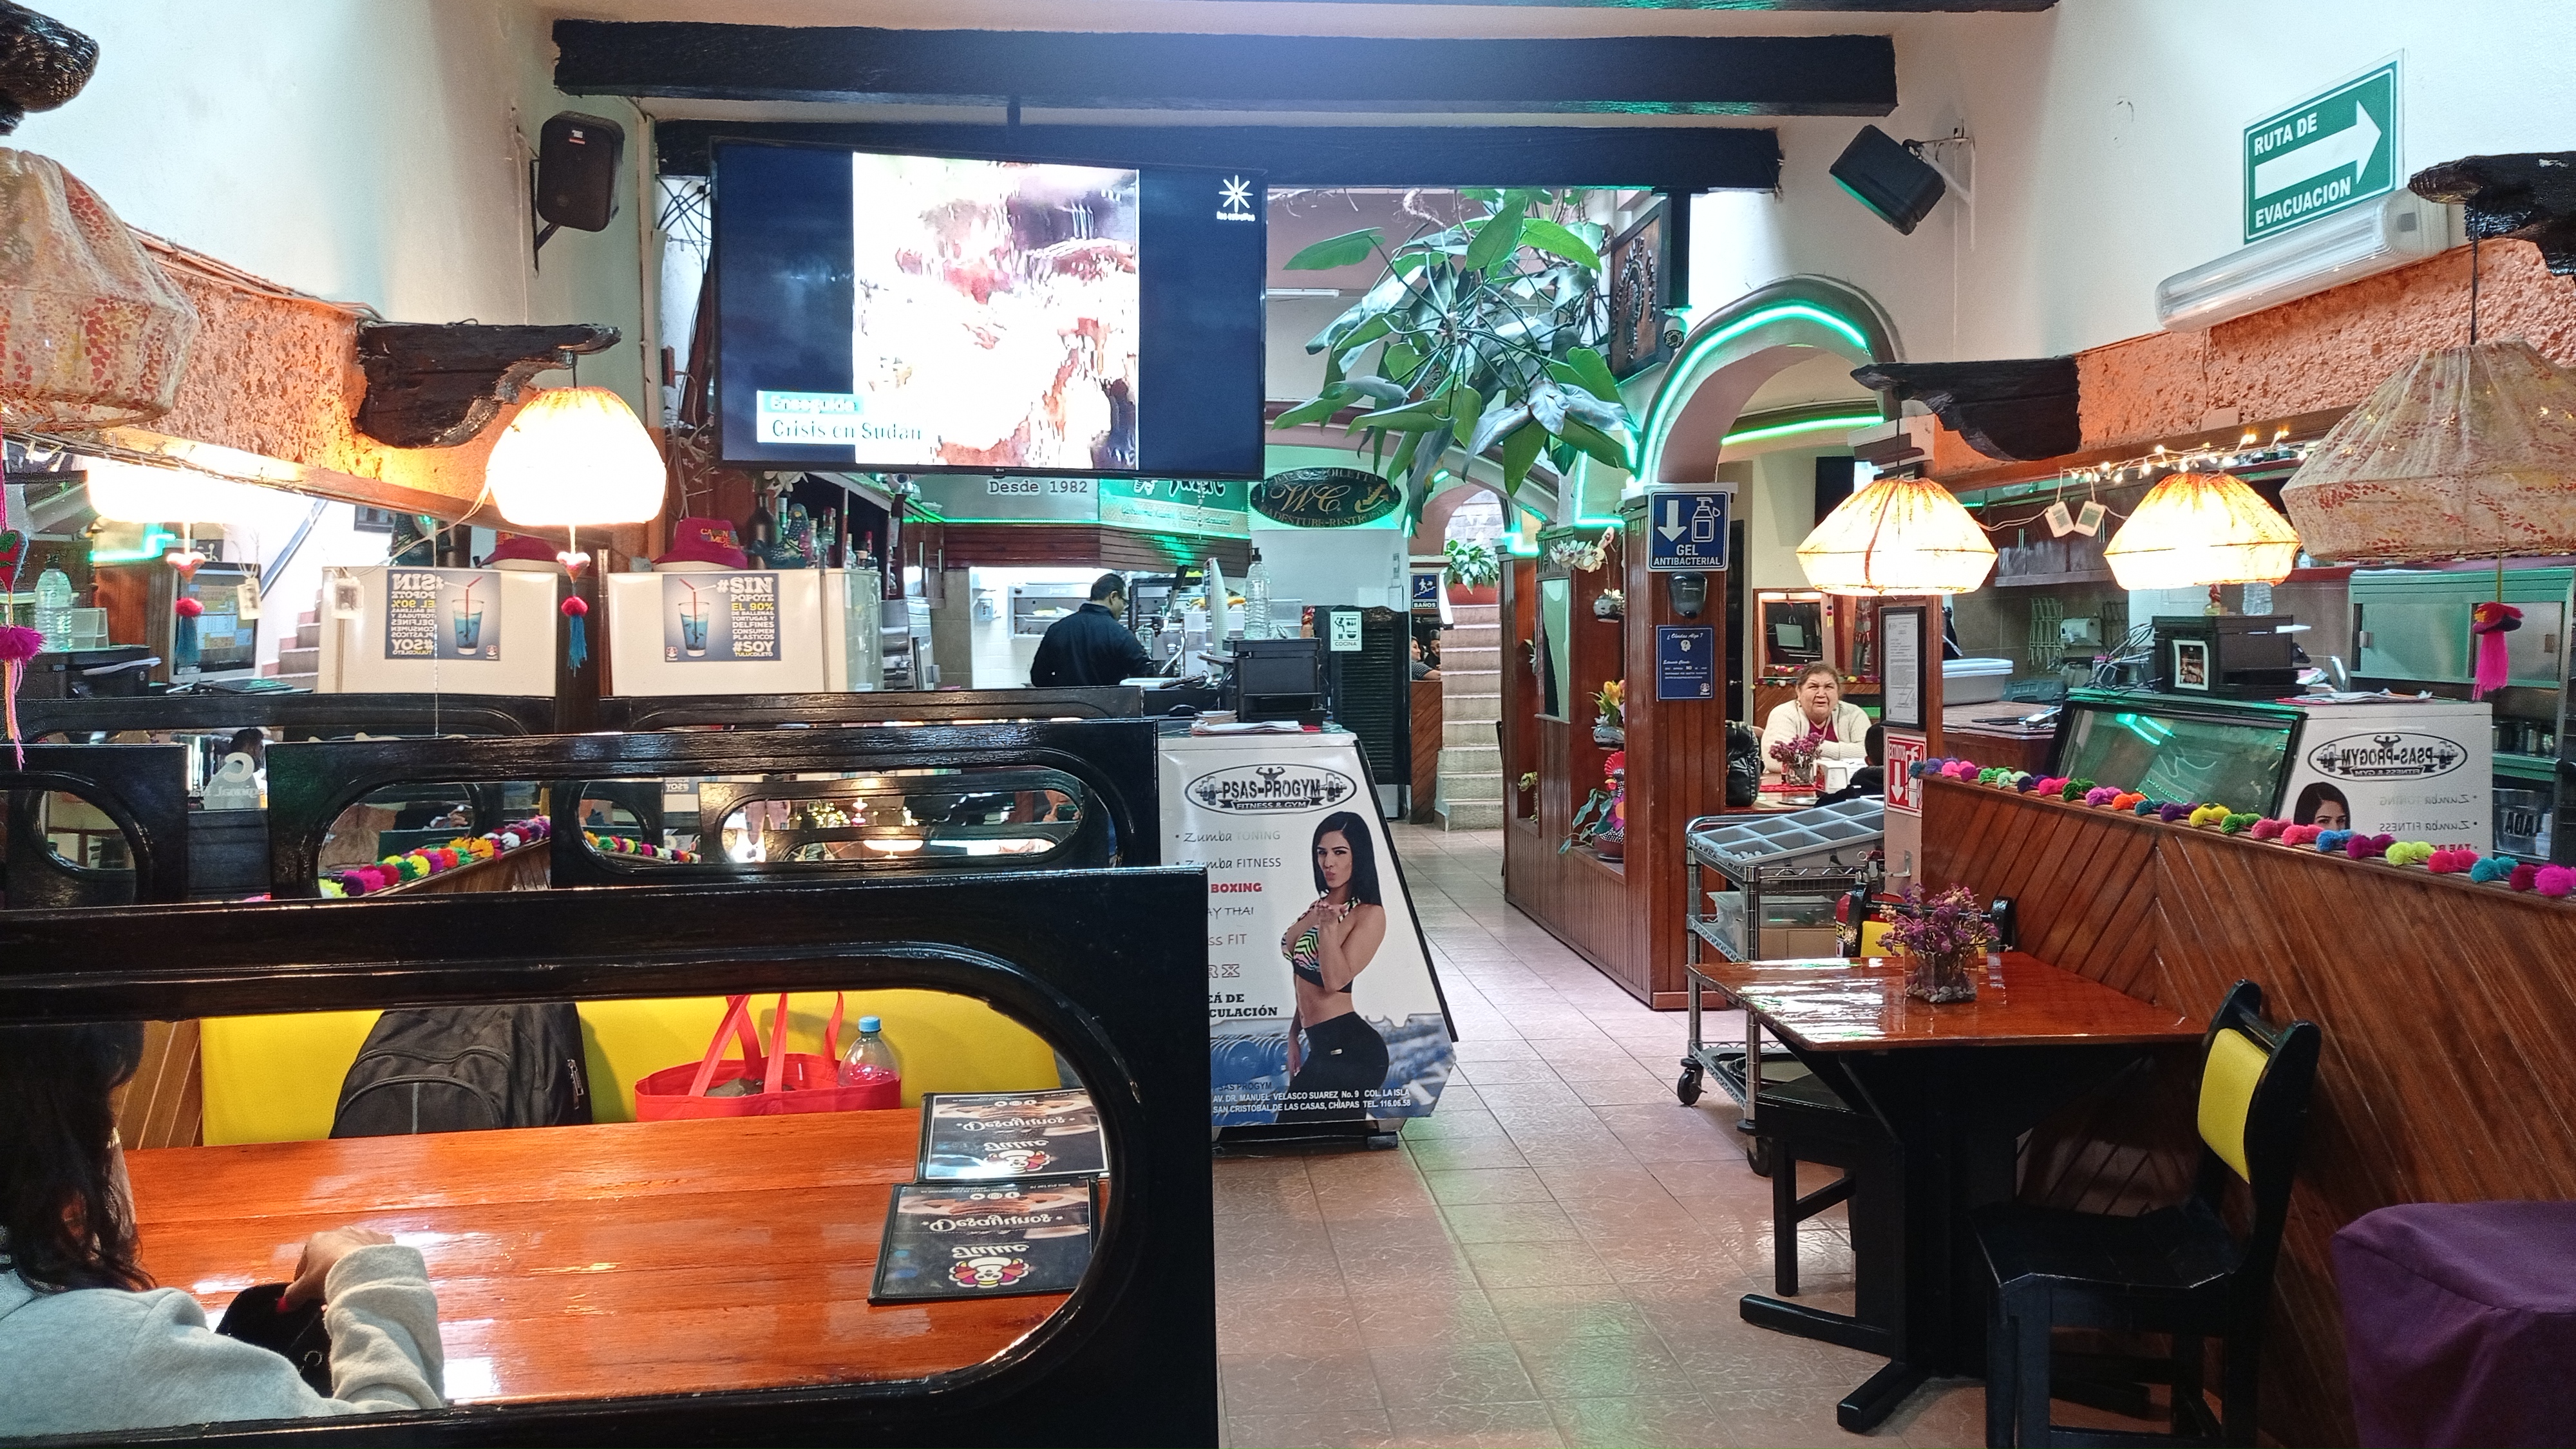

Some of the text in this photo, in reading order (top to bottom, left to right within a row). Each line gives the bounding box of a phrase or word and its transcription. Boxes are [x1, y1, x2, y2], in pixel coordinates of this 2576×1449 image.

[2254, 112, 2318, 156] RUTA DE
[2255, 176, 2351, 228] EVACUACION
[772, 419, 826, 437] Crisis
[833, 424, 854, 438] en
[990, 480, 1088, 493] Desde 1982
[1270, 483, 1350, 515] W.C.
[1676, 544, 1699, 556] GEL
[1653, 557, 1721, 566] ANTIBACTERIAL
[716, 576, 773, 594] #SIN
[732, 603, 774, 611] EL 90%
[732, 641, 775, 652] #SOY
[1222, 778, 1320, 799] PSAS-PROGYM
[1183, 830, 1280, 842] Zumba TONING
[1237, 857, 1281, 867] FITNESS
[1211, 882, 1262, 893] BOXING
[1225, 907, 1254, 916] THAI
[1228, 934, 1247, 945] FIT
[1226, 994, 1244, 1003] DE
[1236, 1081, 1272, 1091] PROGYM
[1240, 1094, 1270, 1102] MANUEL
[1273, 1092, 1308, 1101] VELASCO
[1309, 1091, 1339, 1099] SUAREZ
[1213, 1105, 1228, 1113] SAN
[1229, 1104, 1271, 1113] CRISTOBAL
[1272, 1103, 1283, 1112] DE
[1283, 1103, 1299, 1111] LAS
[1300, 1101, 1327, 1110] CASAS,
[1328, 1100, 1360, 1110] CHIAPAS
[1379, 1099, 1411, 1107] 116.06.58
